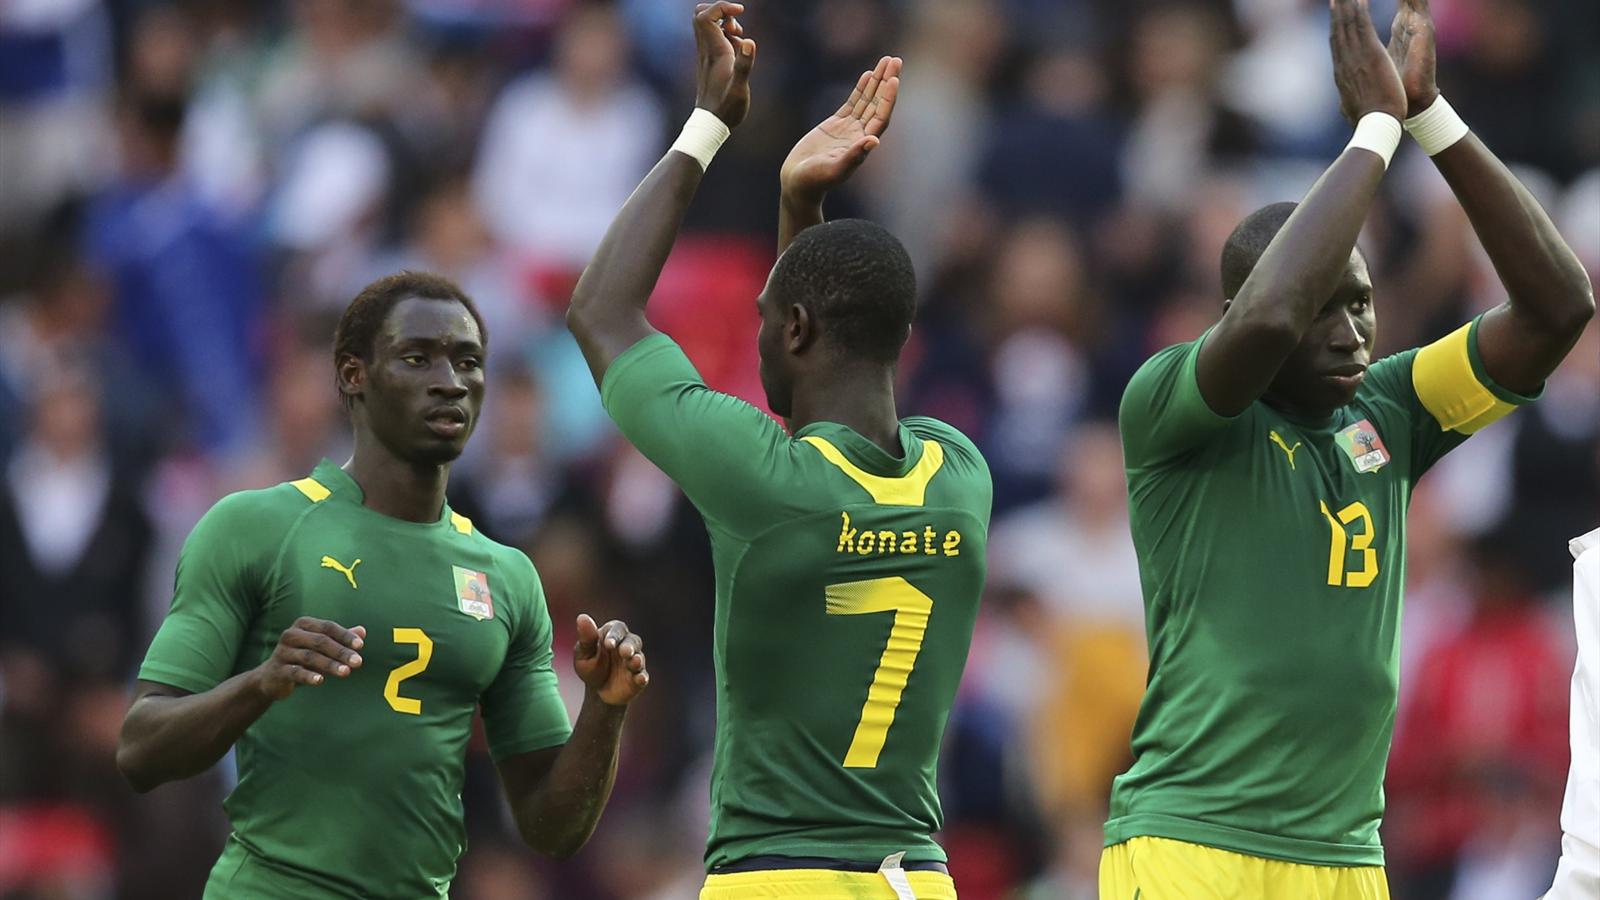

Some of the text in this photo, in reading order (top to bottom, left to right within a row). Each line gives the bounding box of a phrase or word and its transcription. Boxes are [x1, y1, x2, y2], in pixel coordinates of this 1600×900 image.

[836, 511, 962, 557] konate
[1319, 501, 1379, 589] 13
[383, 627, 434, 715] 2
[824, 576, 934, 769] 7
